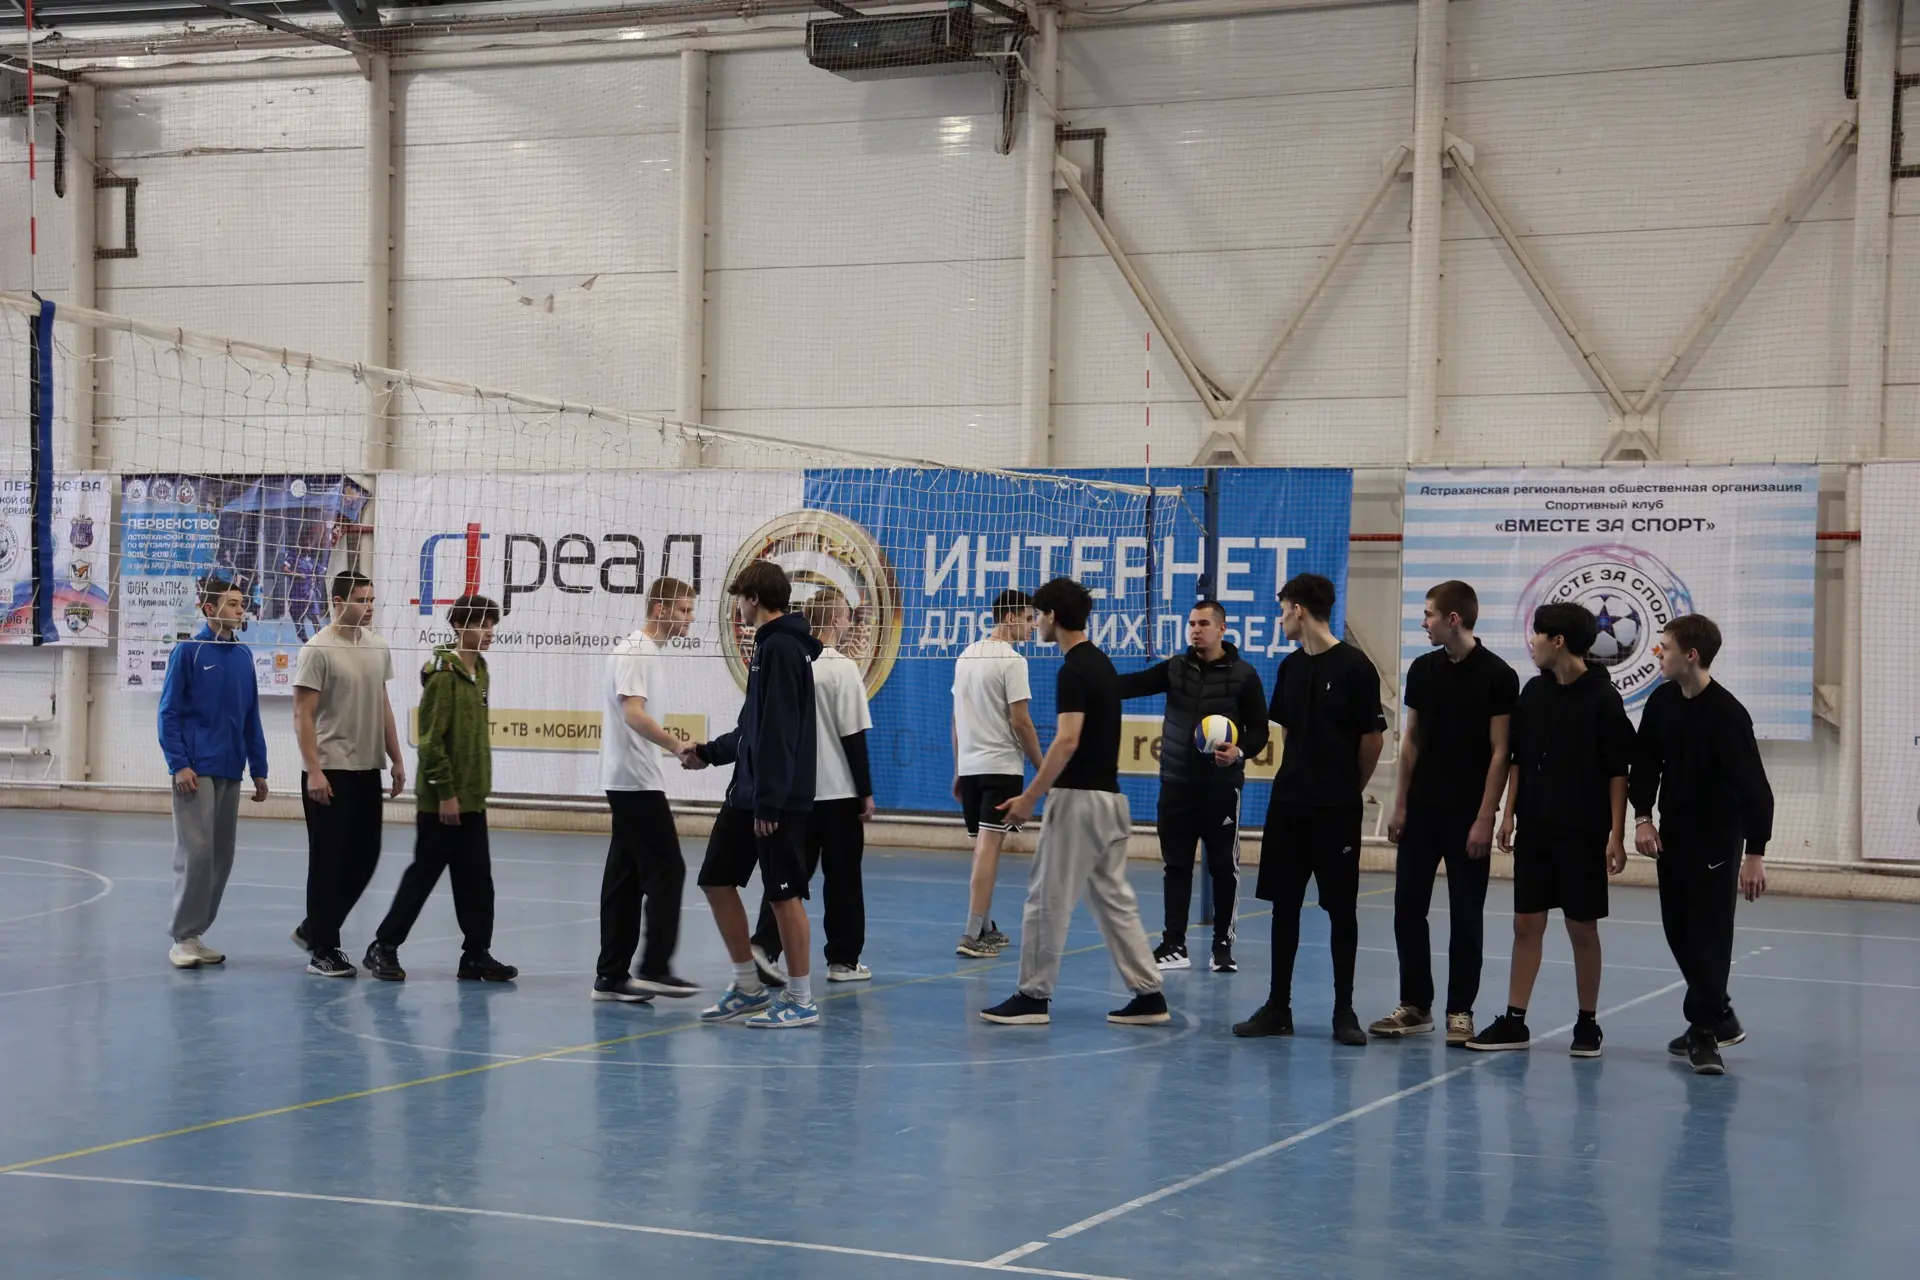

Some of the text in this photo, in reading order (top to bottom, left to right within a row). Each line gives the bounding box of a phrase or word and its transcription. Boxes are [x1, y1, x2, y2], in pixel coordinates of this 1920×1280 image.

[4, 481, 101, 492] ПЕРНСТВА
[1420, 483, 1802, 496] Астраханская региональная общественная организация
[1546, 500, 1664, 511] Спортивный клуб
[127, 519, 220, 530] ПЕРВЕНСТВО
[1495, 519, 1716, 532] «ВМЕСТЕ ЗА СПОРТ»
[502, 533, 703, 617] реал
[925, 535, 1307, 602] ИНТЕРНЕТ
[1600, 569, 1626, 583] ЗА
[527, 630, 609, 648] провайдер
